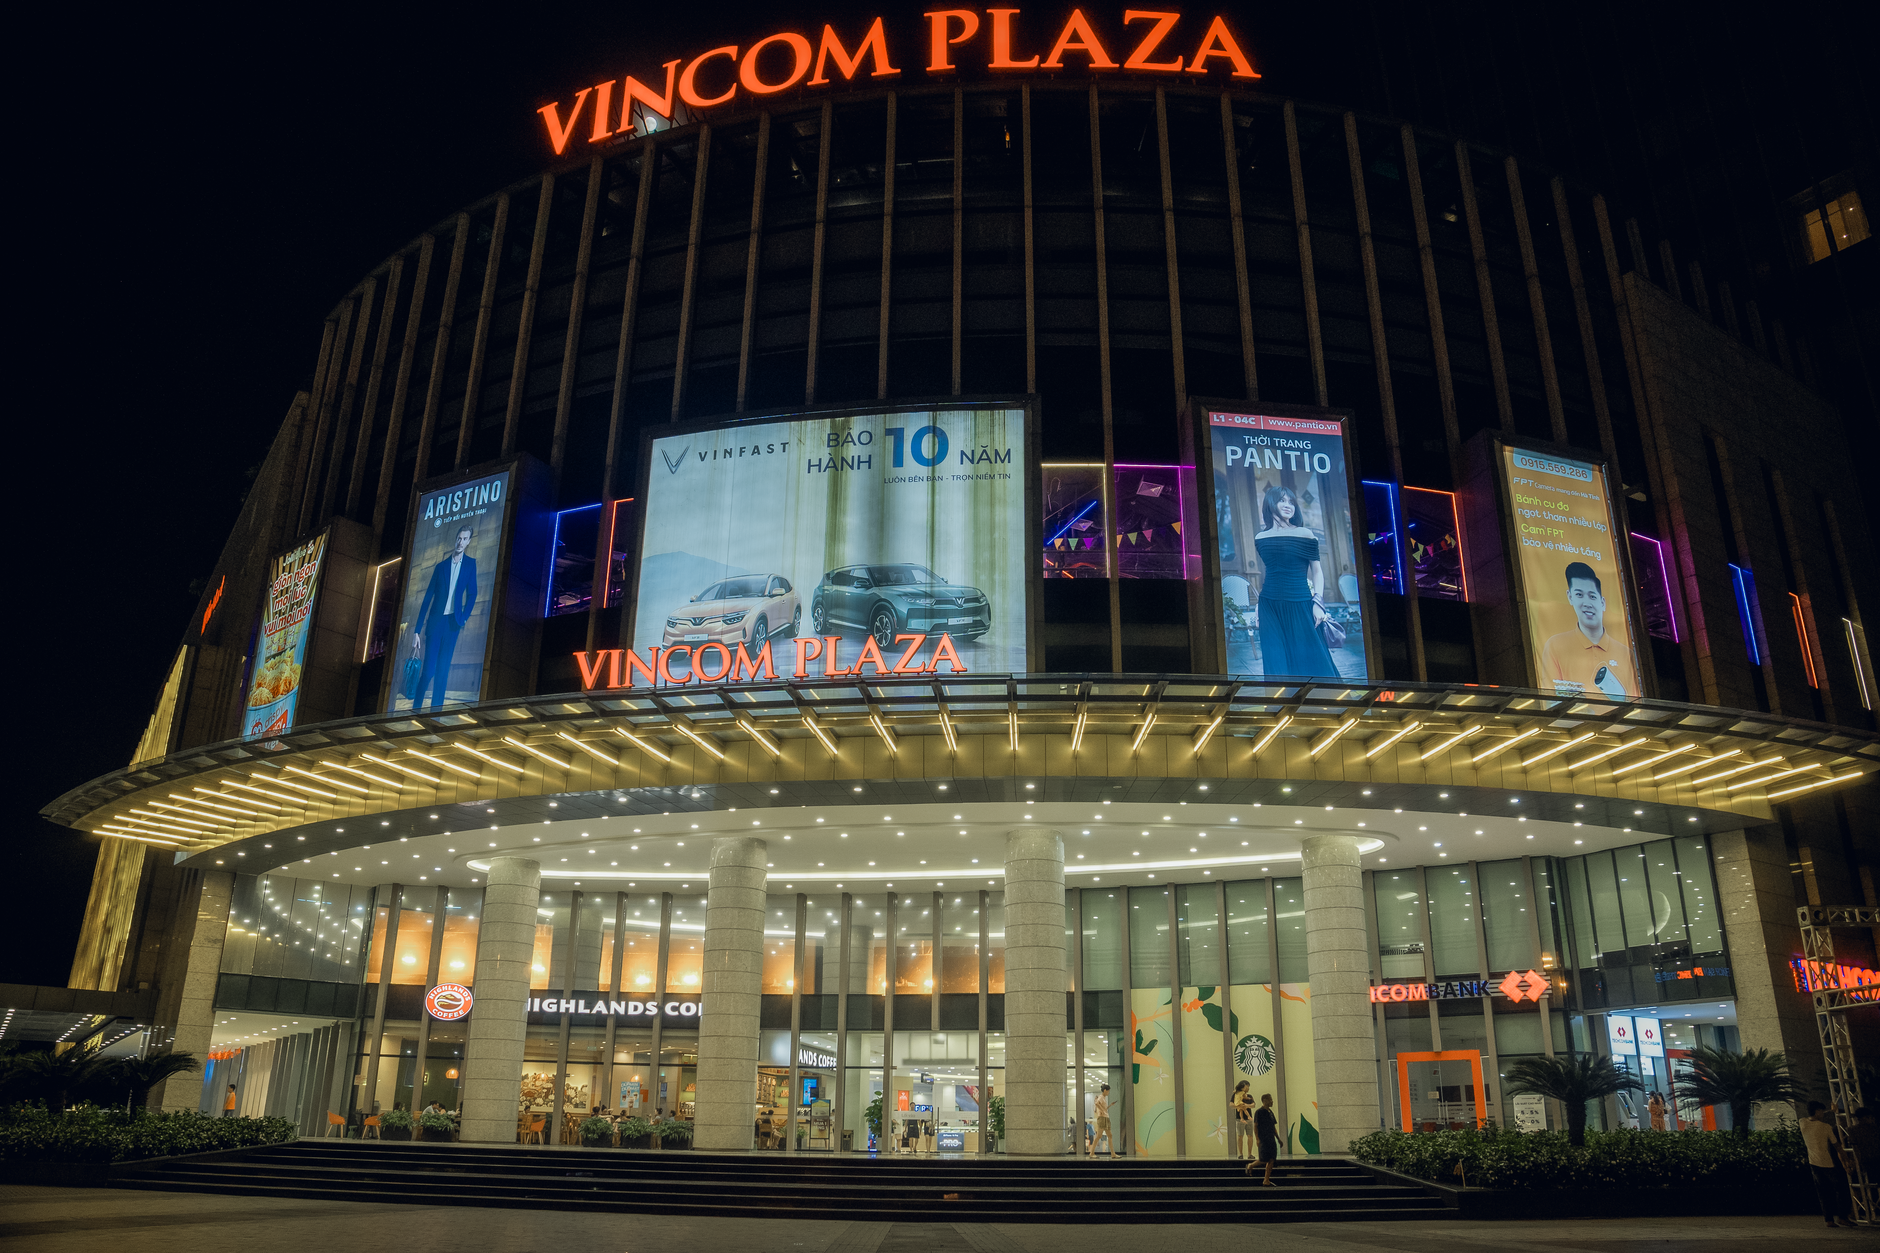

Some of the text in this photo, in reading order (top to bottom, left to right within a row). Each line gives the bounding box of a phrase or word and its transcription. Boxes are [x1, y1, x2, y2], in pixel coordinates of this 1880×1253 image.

[536, 8, 1262, 156] VINCOM PLAZA
[1213, 414, 1226, 423] L1
[1235, 415, 1256, 425] 04C
[1268, 418, 1338, 431] www.pantio.vn
[827, 427, 873, 448] BẢO
[884, 425, 950, 469] 10
[1243, 435, 1312, 450] THỜI TRANG
[698, 441, 790, 462] VINFAST
[959, 445, 1012, 466] NĂM
[1225, 445, 1332, 474] PANTIO
[807, 452, 872, 474] HÀNH
[1520, 456, 1588, 479] 0915.559.286
[884, 474, 906, 484] LUÔN
[908, 473, 925, 483] BÊN
[1513, 477, 1534, 487] FPT
[424, 480, 502, 520] ARISTINO
[1515, 493, 1542, 507] Bánh
[1543, 500, 1556, 509] cu
[1517, 507, 1542, 519] ngọt
[1542, 511, 1568, 524] thơm
[1520, 523, 1565, 539] Cam FPT
[293, 561, 317, 585] ngon
[291, 582, 307, 604] lúc
[264, 614, 279, 635] vui
[573, 632, 968, 690] VINCOM PLAZA
[428, 984, 471, 1003] HIGHLANDS
[432, 1008, 465, 1019] COFFEE
